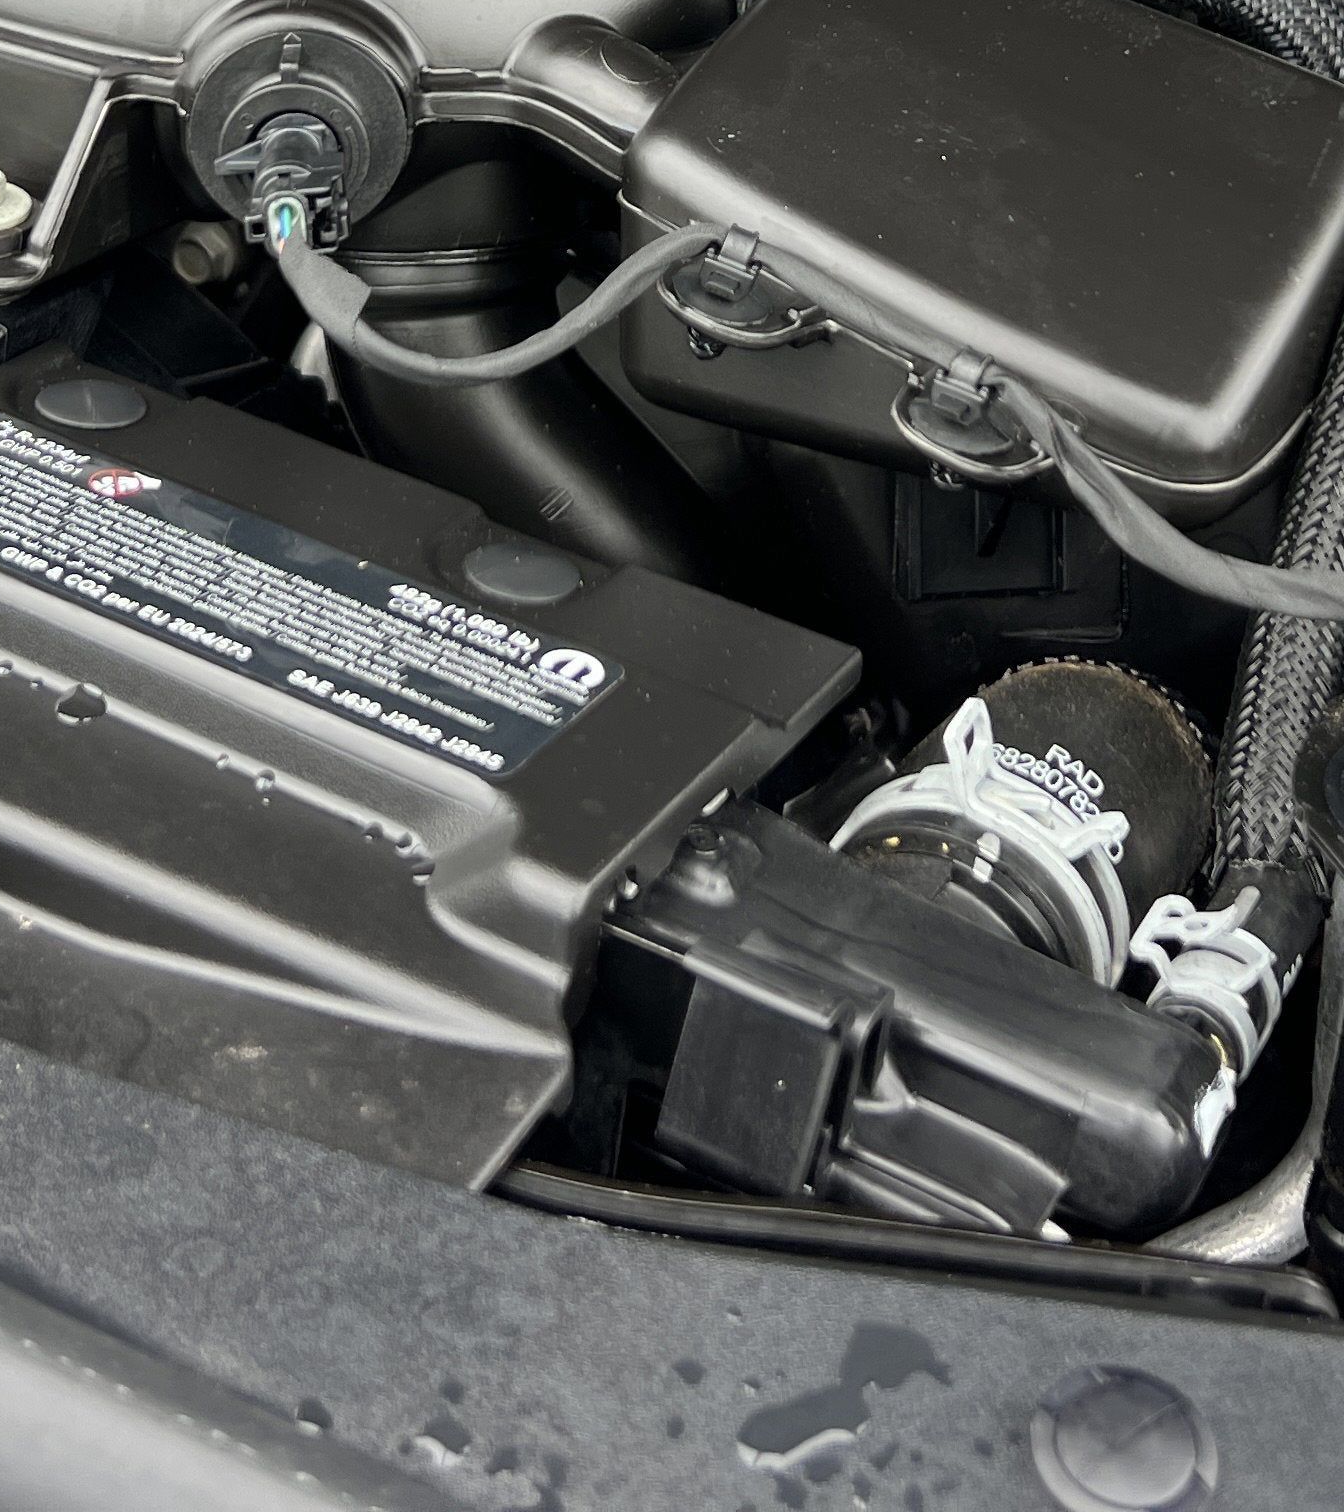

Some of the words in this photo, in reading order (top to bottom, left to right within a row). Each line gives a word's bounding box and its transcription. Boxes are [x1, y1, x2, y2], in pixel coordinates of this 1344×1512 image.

[14, 431, 91, 464] R-1234yf
[39, 455, 83, 476] 0.501
[0, 547, 49, 571] GWP
[64, 574, 107, 599] CO2
[102, 593, 140, 613] per
[138, 605, 171, 626] EU
[168, 618, 252, 662] 2024/573
[288, 670, 334, 698] SAE
[332, 690, 382, 718] J639
[380, 711, 443, 744] J2842
[441, 737, 504, 771] J2845
[1045, 743, 1105, 799] RAD
